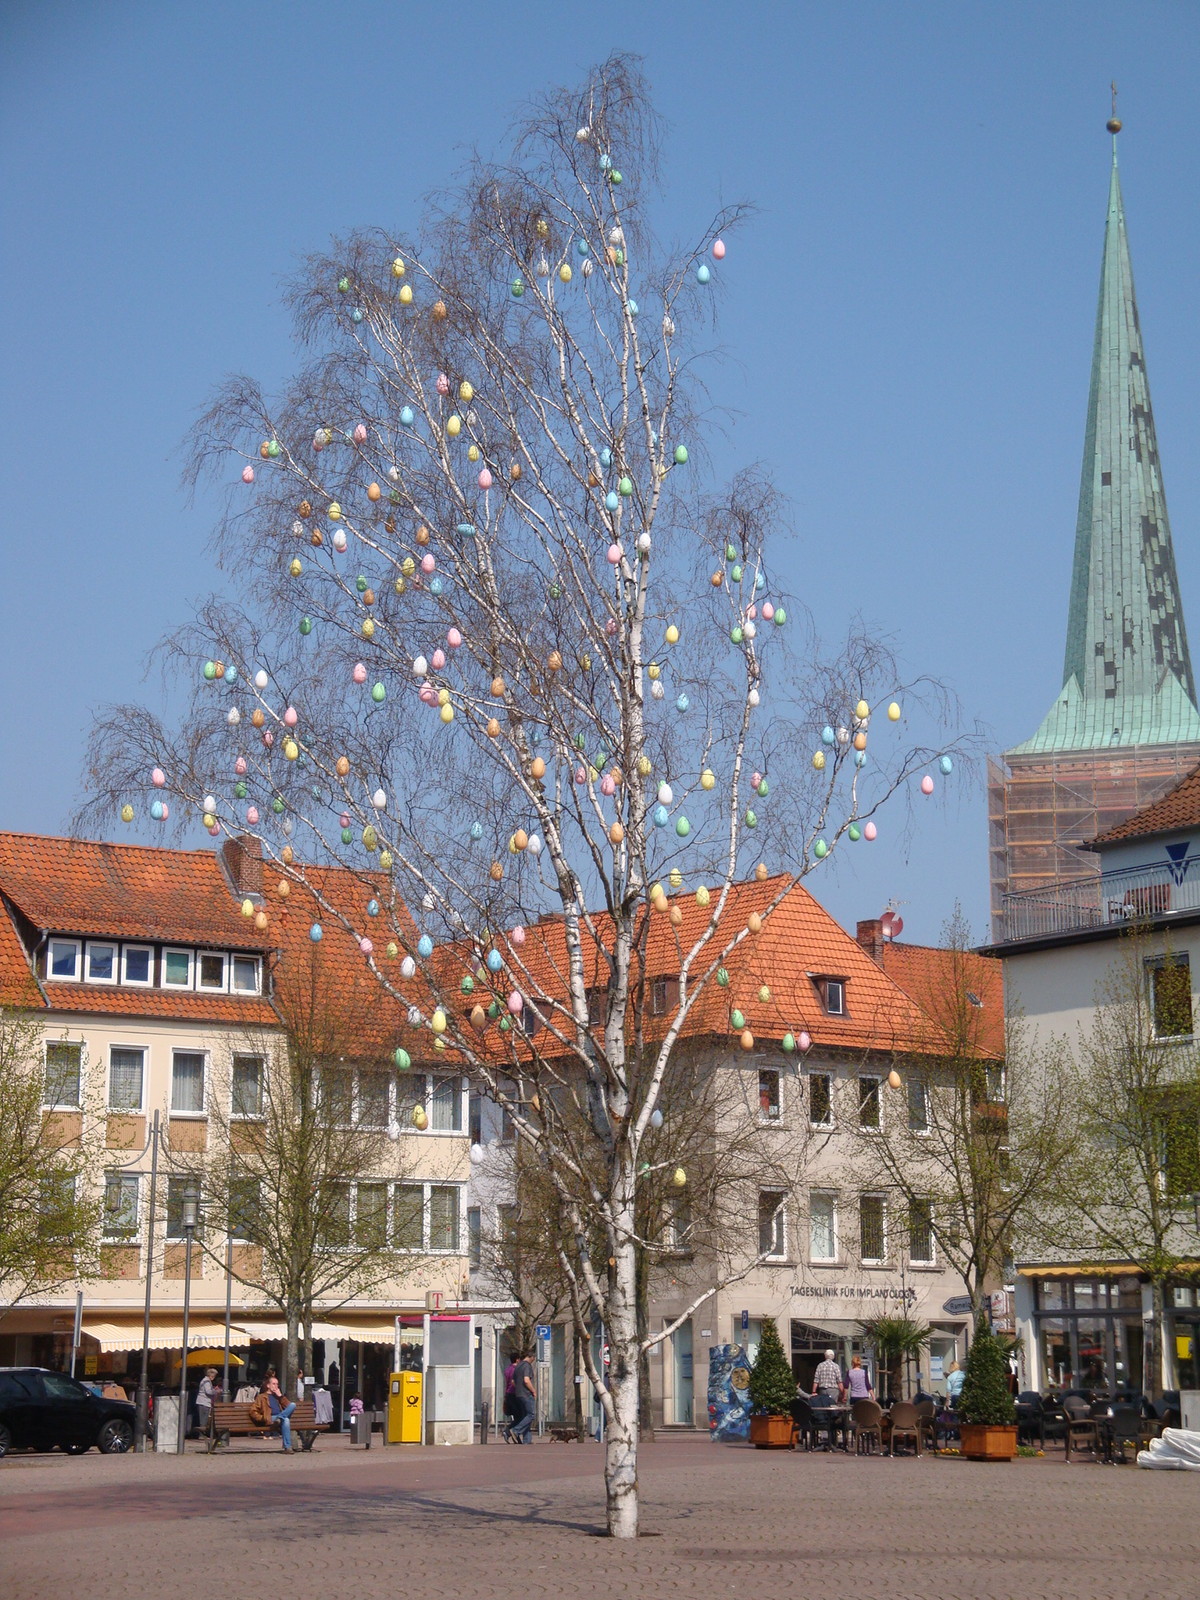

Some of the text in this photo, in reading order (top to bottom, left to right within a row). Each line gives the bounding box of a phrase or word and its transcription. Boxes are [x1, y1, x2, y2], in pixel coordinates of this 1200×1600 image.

[790, 1286, 916, 1299] TAGESKLINIK FÜR IMPLANTOLOGI
[432, 1293, 443, 1309] T
[540, 1327, 548, 1336] P
